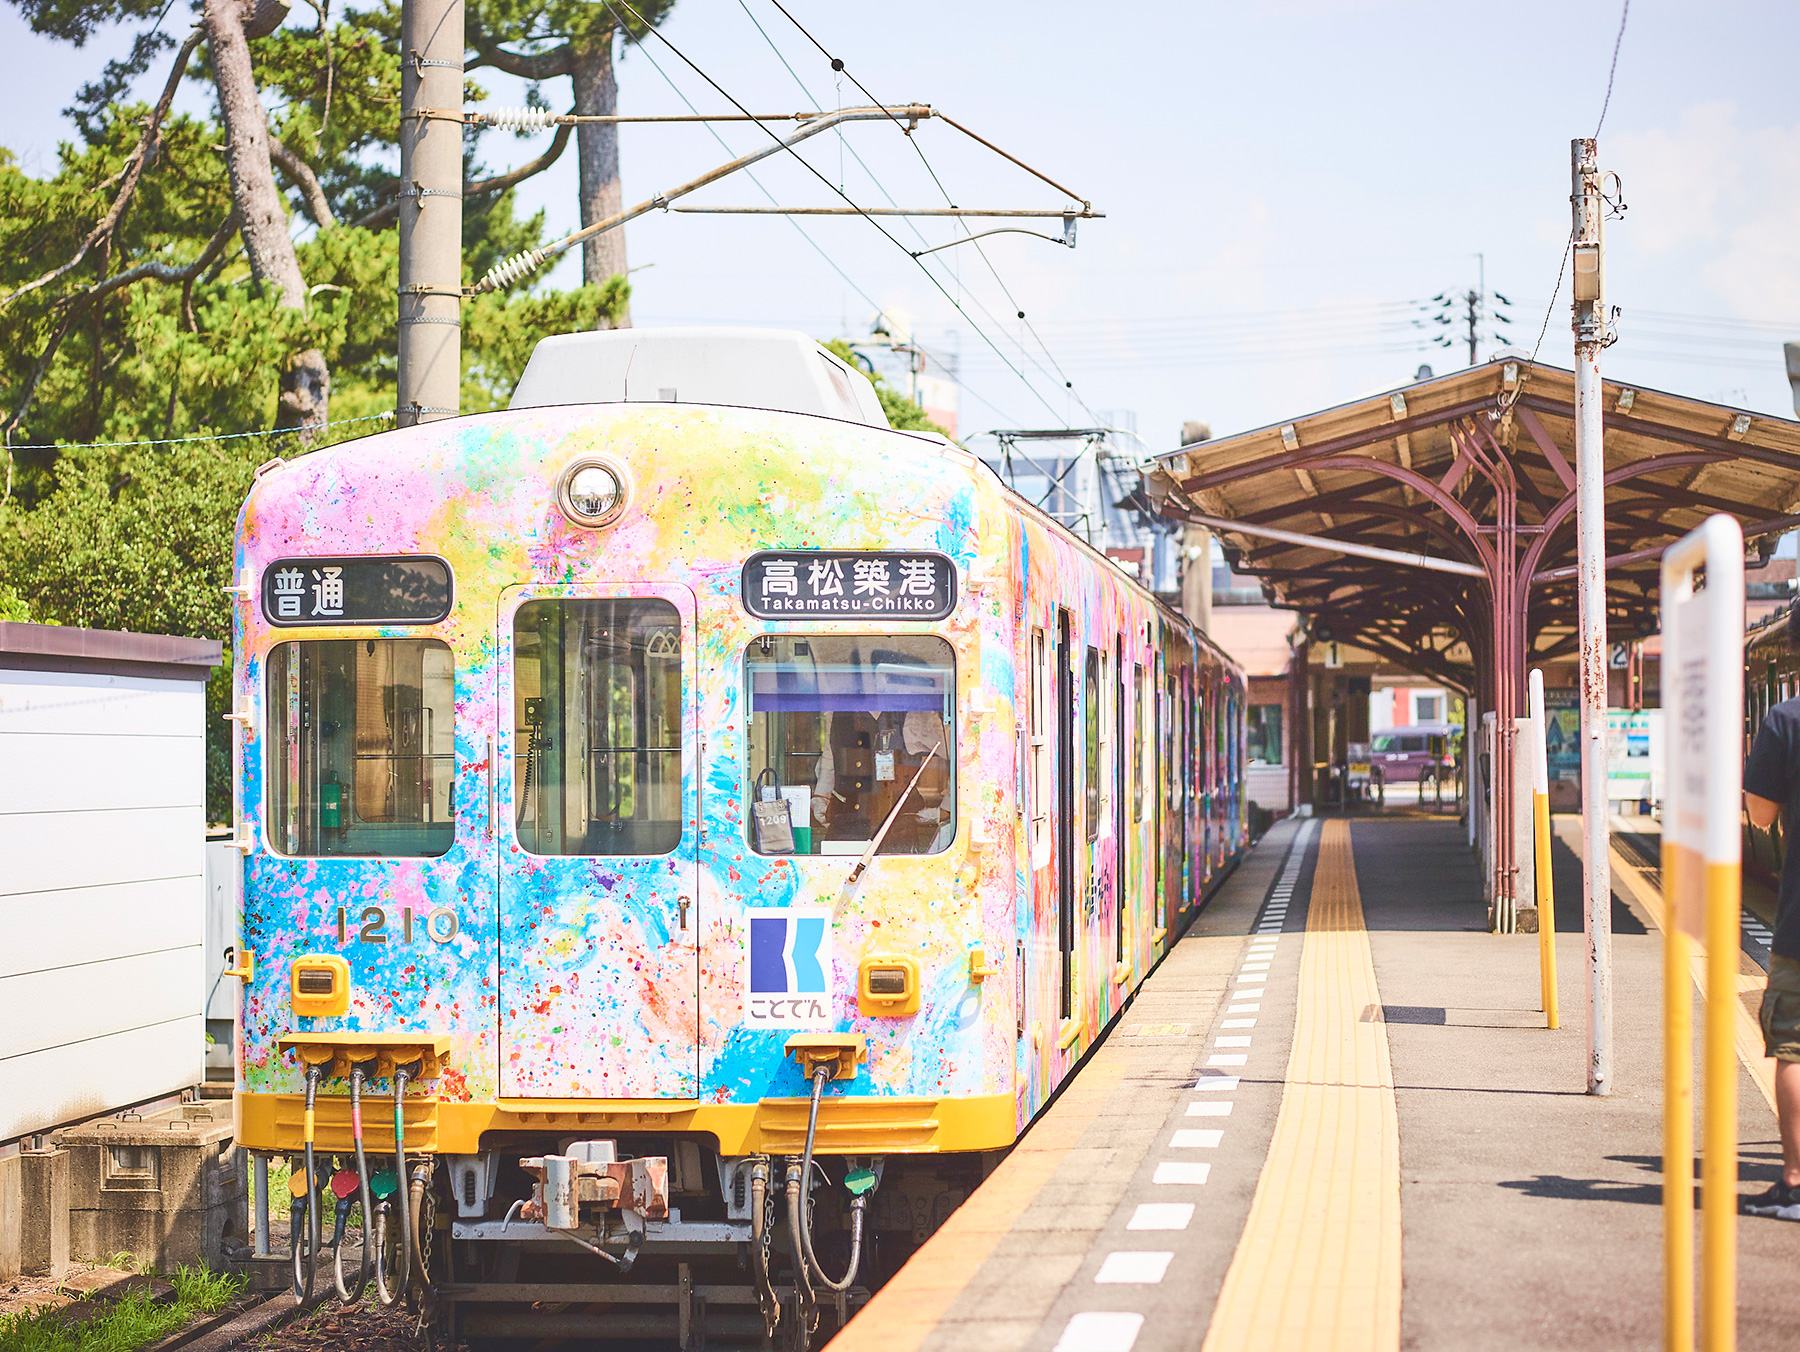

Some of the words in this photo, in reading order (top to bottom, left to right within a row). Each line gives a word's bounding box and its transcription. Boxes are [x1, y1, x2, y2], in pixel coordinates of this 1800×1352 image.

[761, 558, 936, 597] 高松築港
[274, 566, 344, 617] 普通
[761, 597, 935, 611] Takamatsu-Chikko
[1613, 643, 1627, 665] 2
[760, 815, 787, 826] 1209
[336, 906, 459, 944] 1210
[751, 1000, 827, 1019] ことでん
